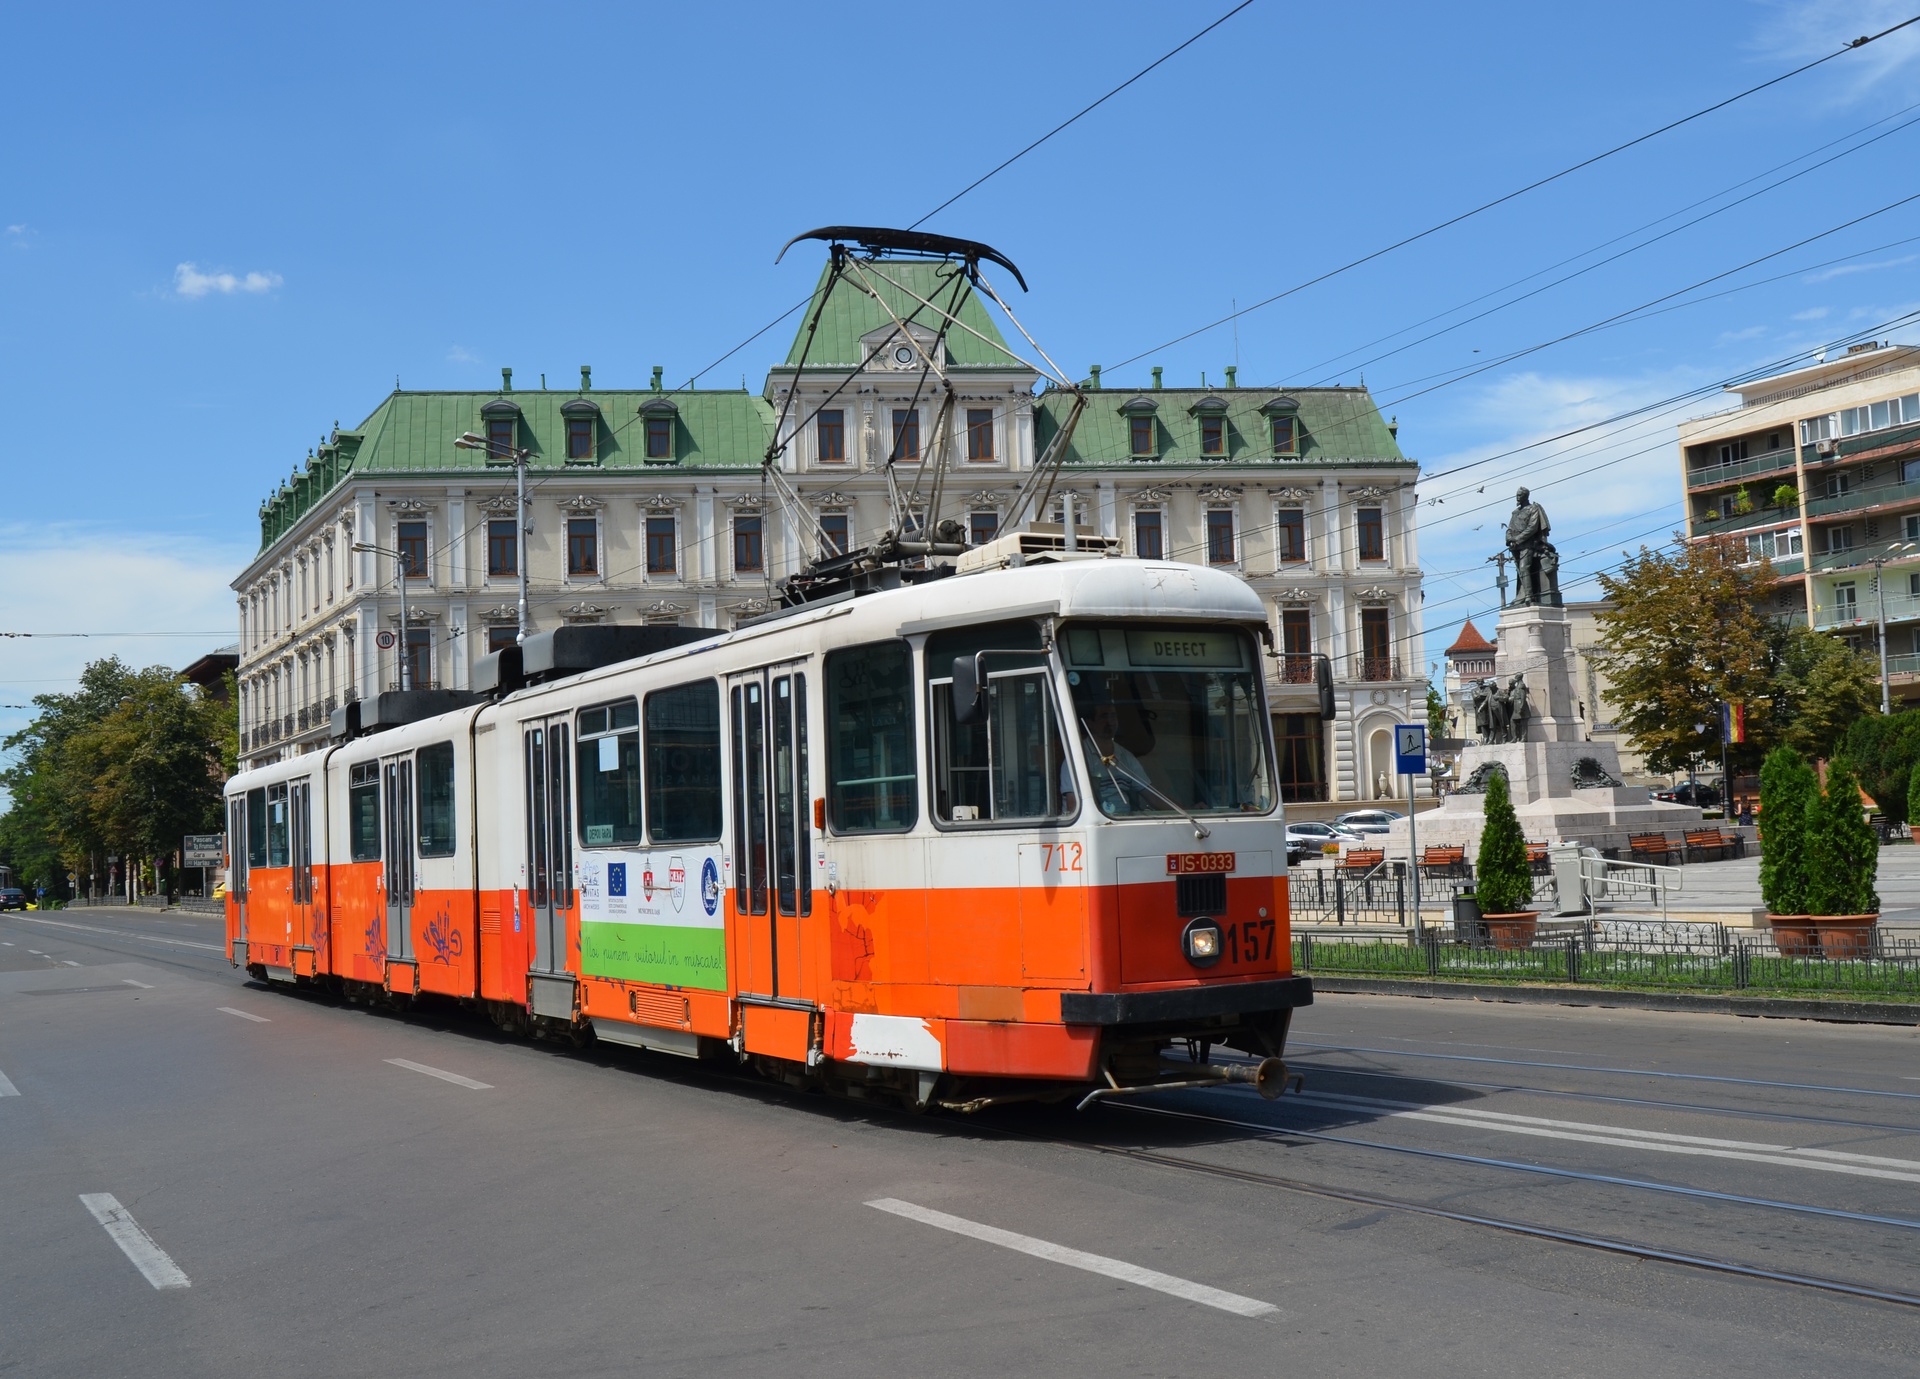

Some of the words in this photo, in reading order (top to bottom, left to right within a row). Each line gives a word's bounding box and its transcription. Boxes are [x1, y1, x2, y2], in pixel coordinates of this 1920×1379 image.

[381, 634, 390, 645] 10
[1153, 641, 1207, 657] DEFECT
[1041, 842, 1083, 872] 712
[585, 937, 599, 959] Noi
[603, 948, 630, 970] punem
[1228, 920, 1275, 964] 157
